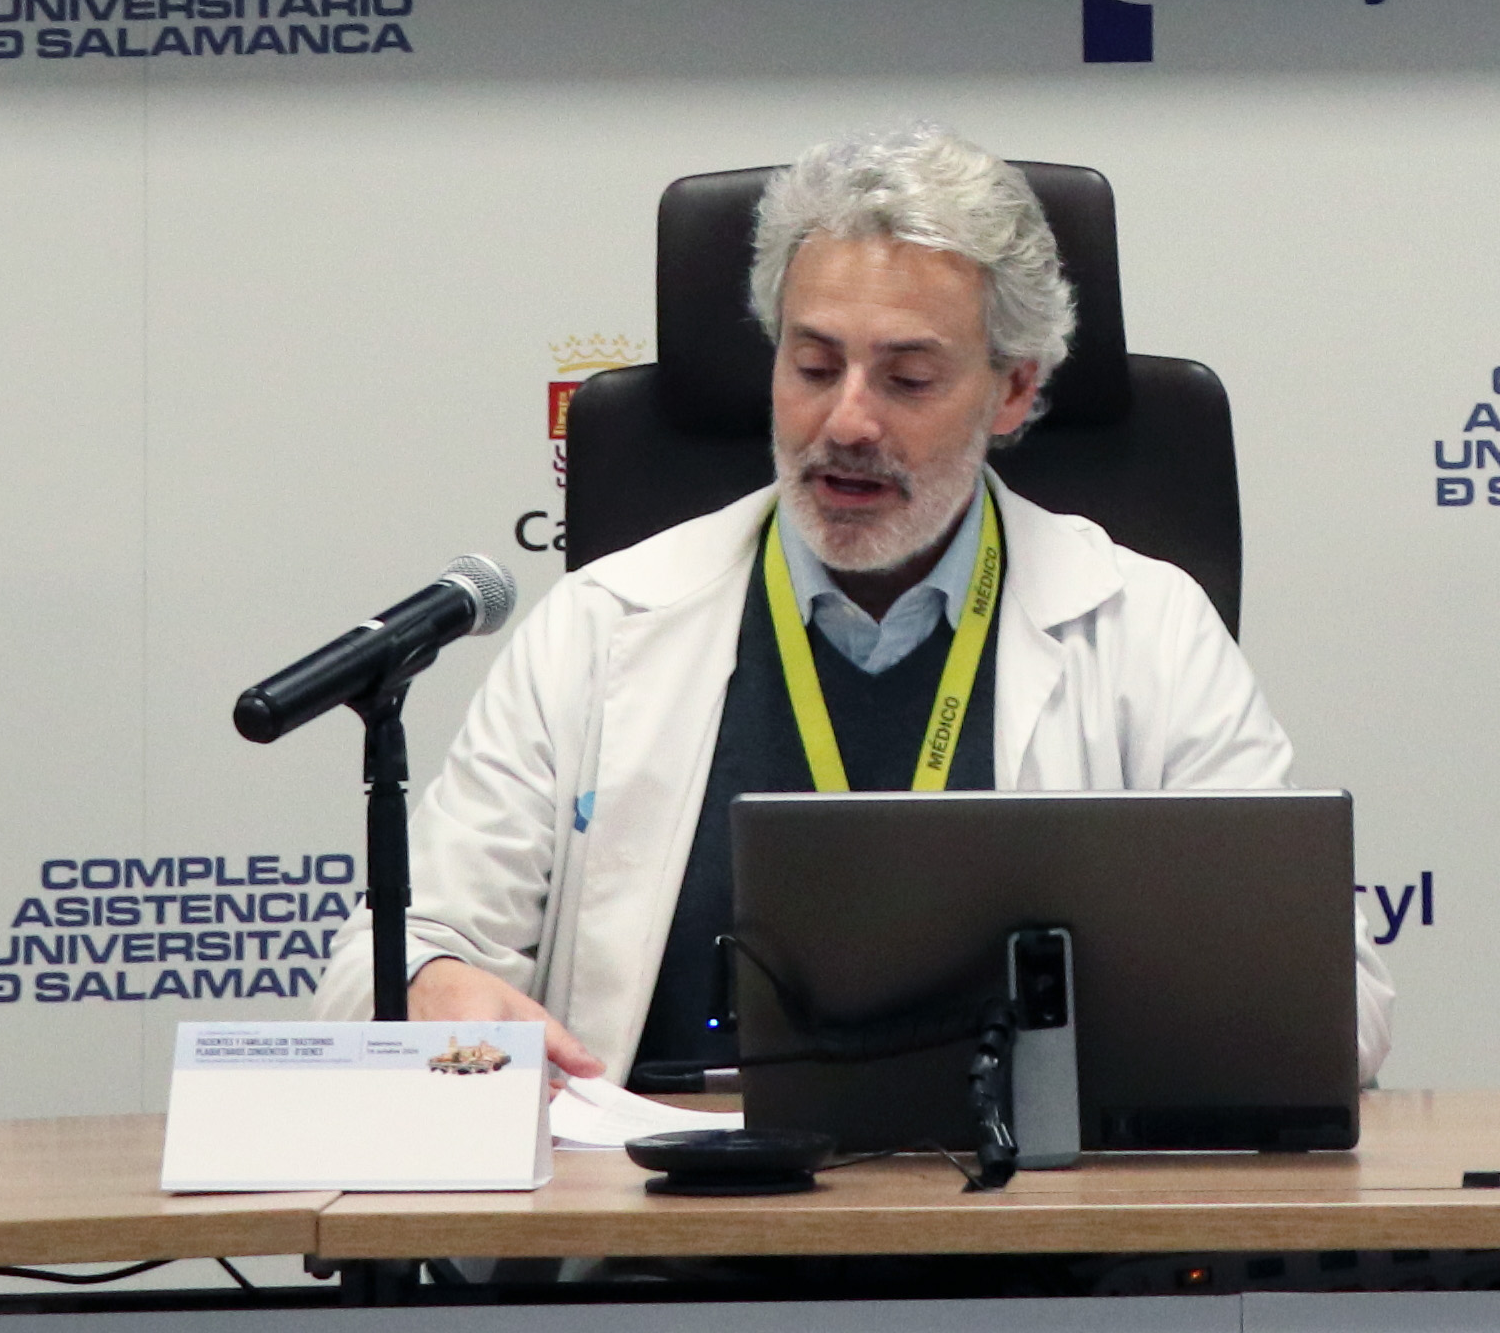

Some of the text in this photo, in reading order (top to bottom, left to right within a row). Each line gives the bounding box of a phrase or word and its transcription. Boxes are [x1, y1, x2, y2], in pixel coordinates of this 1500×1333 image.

[37, 23, 412, 58] SALAMANCA
[972, 547, 997, 617] MÉDICO
[928, 696, 959, 770] MÉDICO
[41, 854, 354, 890] COMPLEJO
[12, 891, 366, 927] ASISTENCIA
